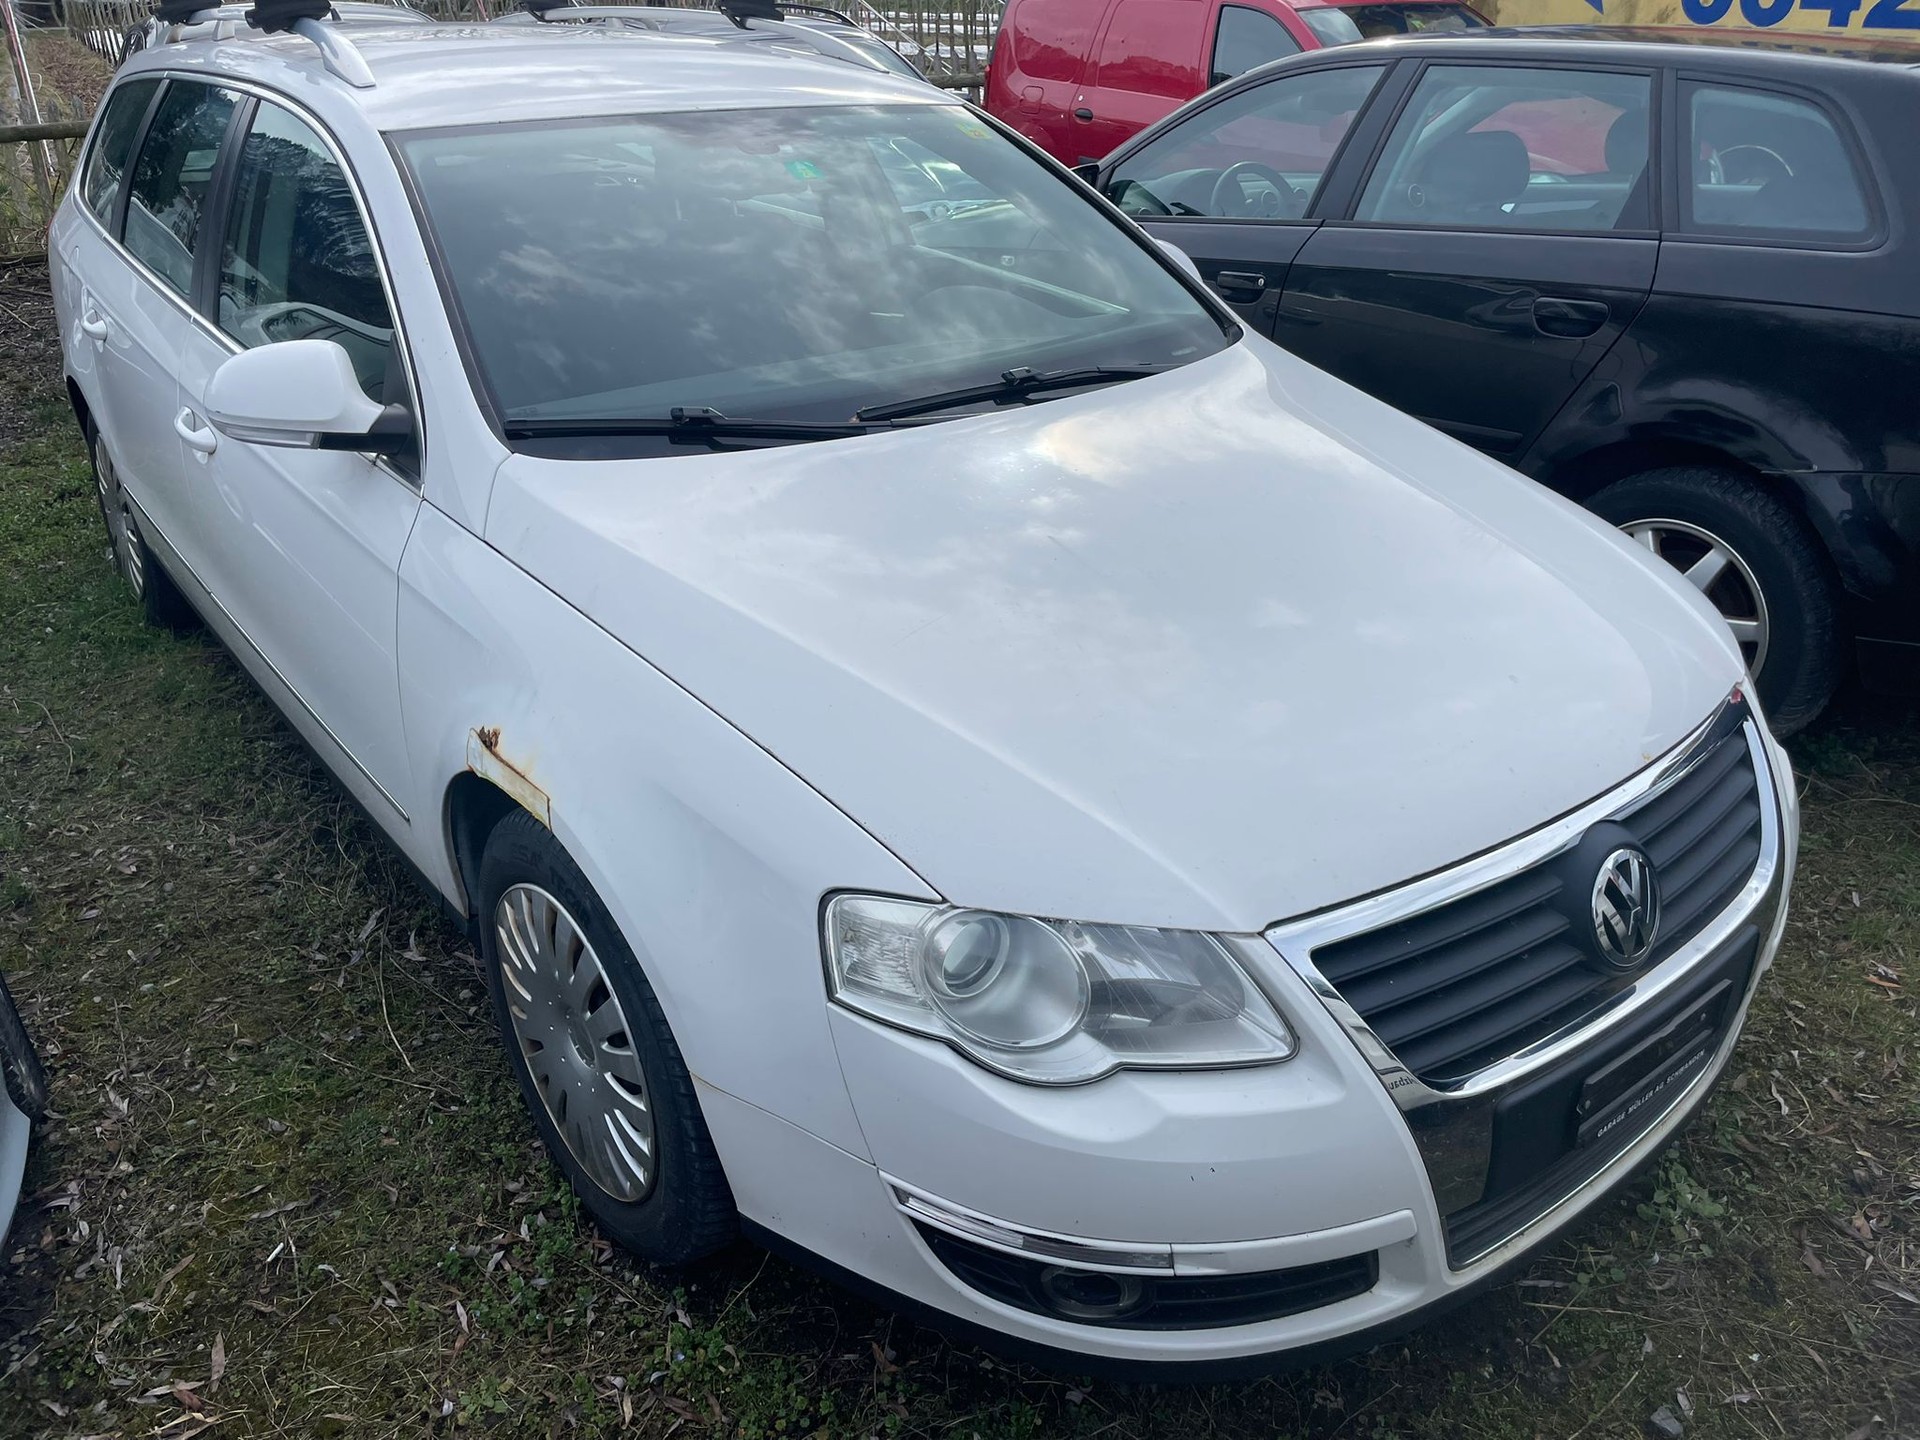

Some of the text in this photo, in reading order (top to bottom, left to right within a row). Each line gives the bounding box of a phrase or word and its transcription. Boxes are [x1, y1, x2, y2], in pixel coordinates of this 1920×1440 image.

[1597, 1111, 1626, 1138] GARAGE
[1627, 1090, 1654, 1115] MÜLLER
[1654, 1081, 1665, 1093] AG
